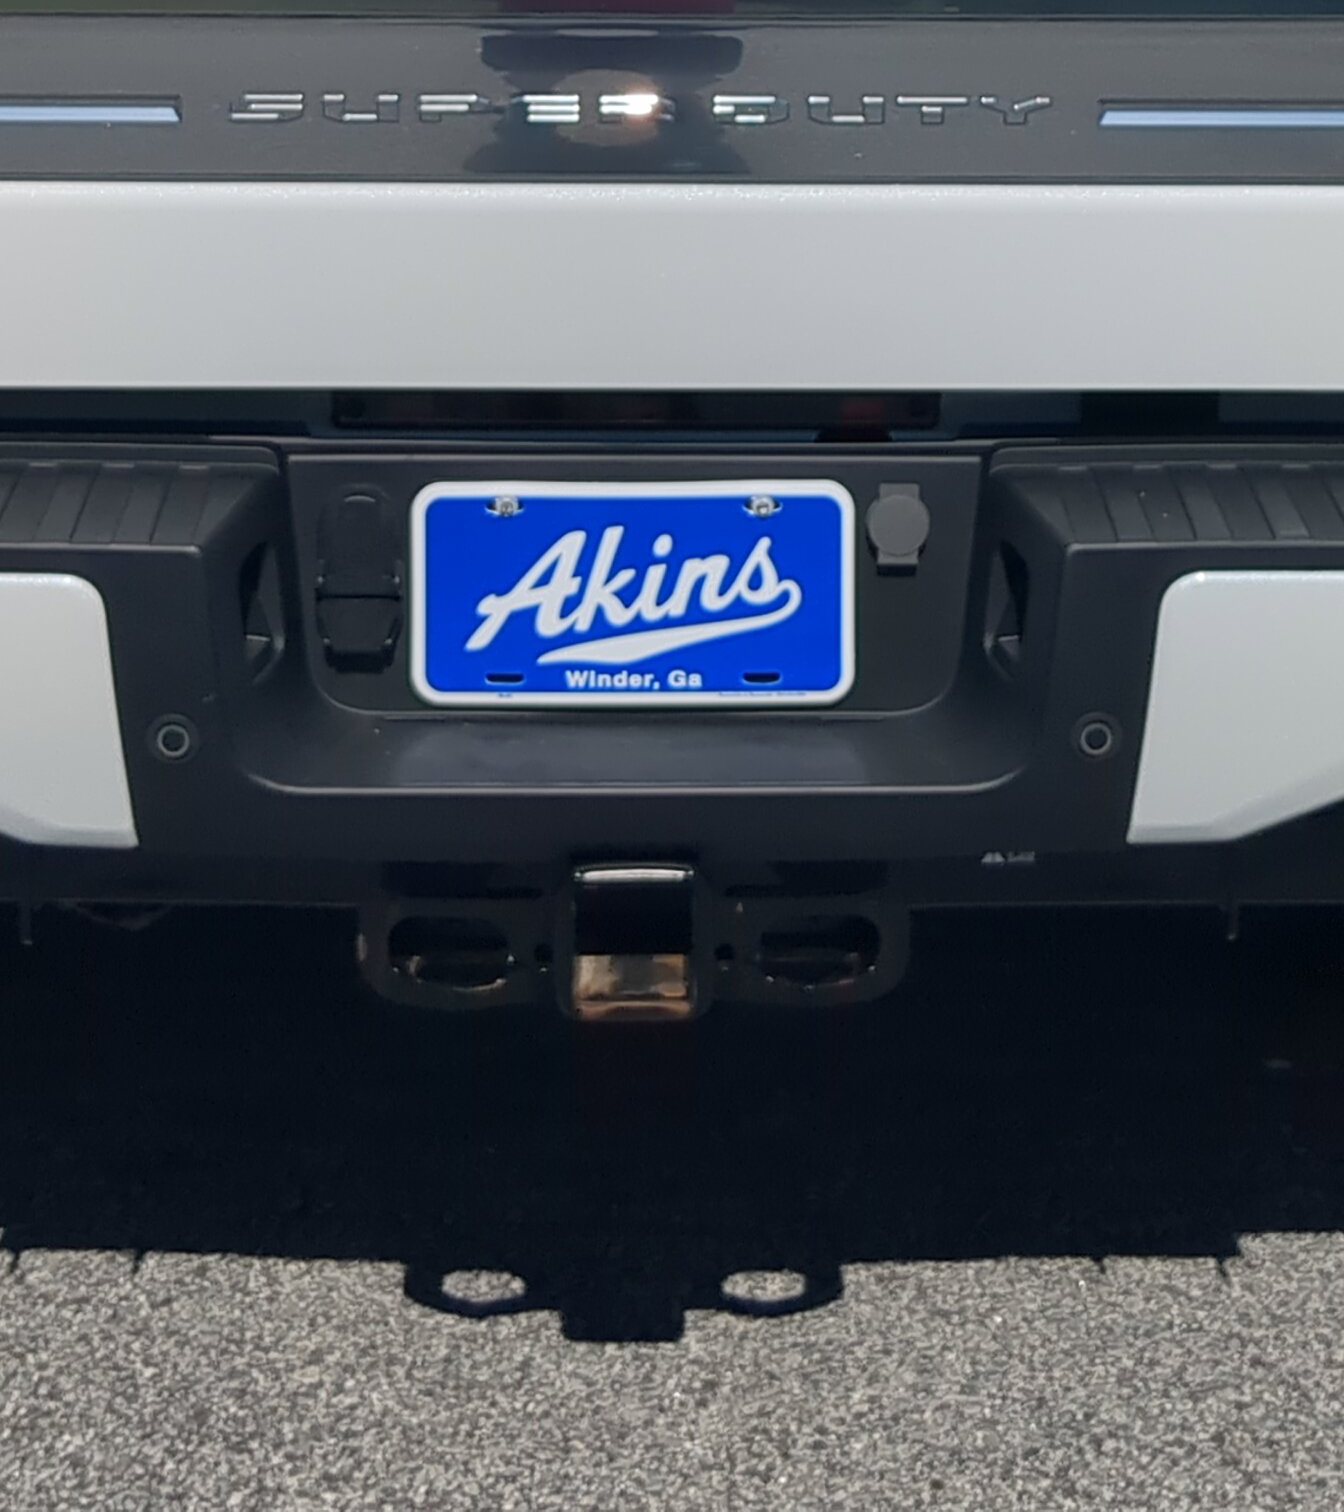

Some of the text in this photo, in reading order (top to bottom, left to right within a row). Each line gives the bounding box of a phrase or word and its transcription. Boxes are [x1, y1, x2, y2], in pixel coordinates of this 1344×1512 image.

[229, 91, 1053, 126] SUPER DUTY
[465, 525, 802, 653] Akins
[566, 669, 702, 690] Winder, Ga
